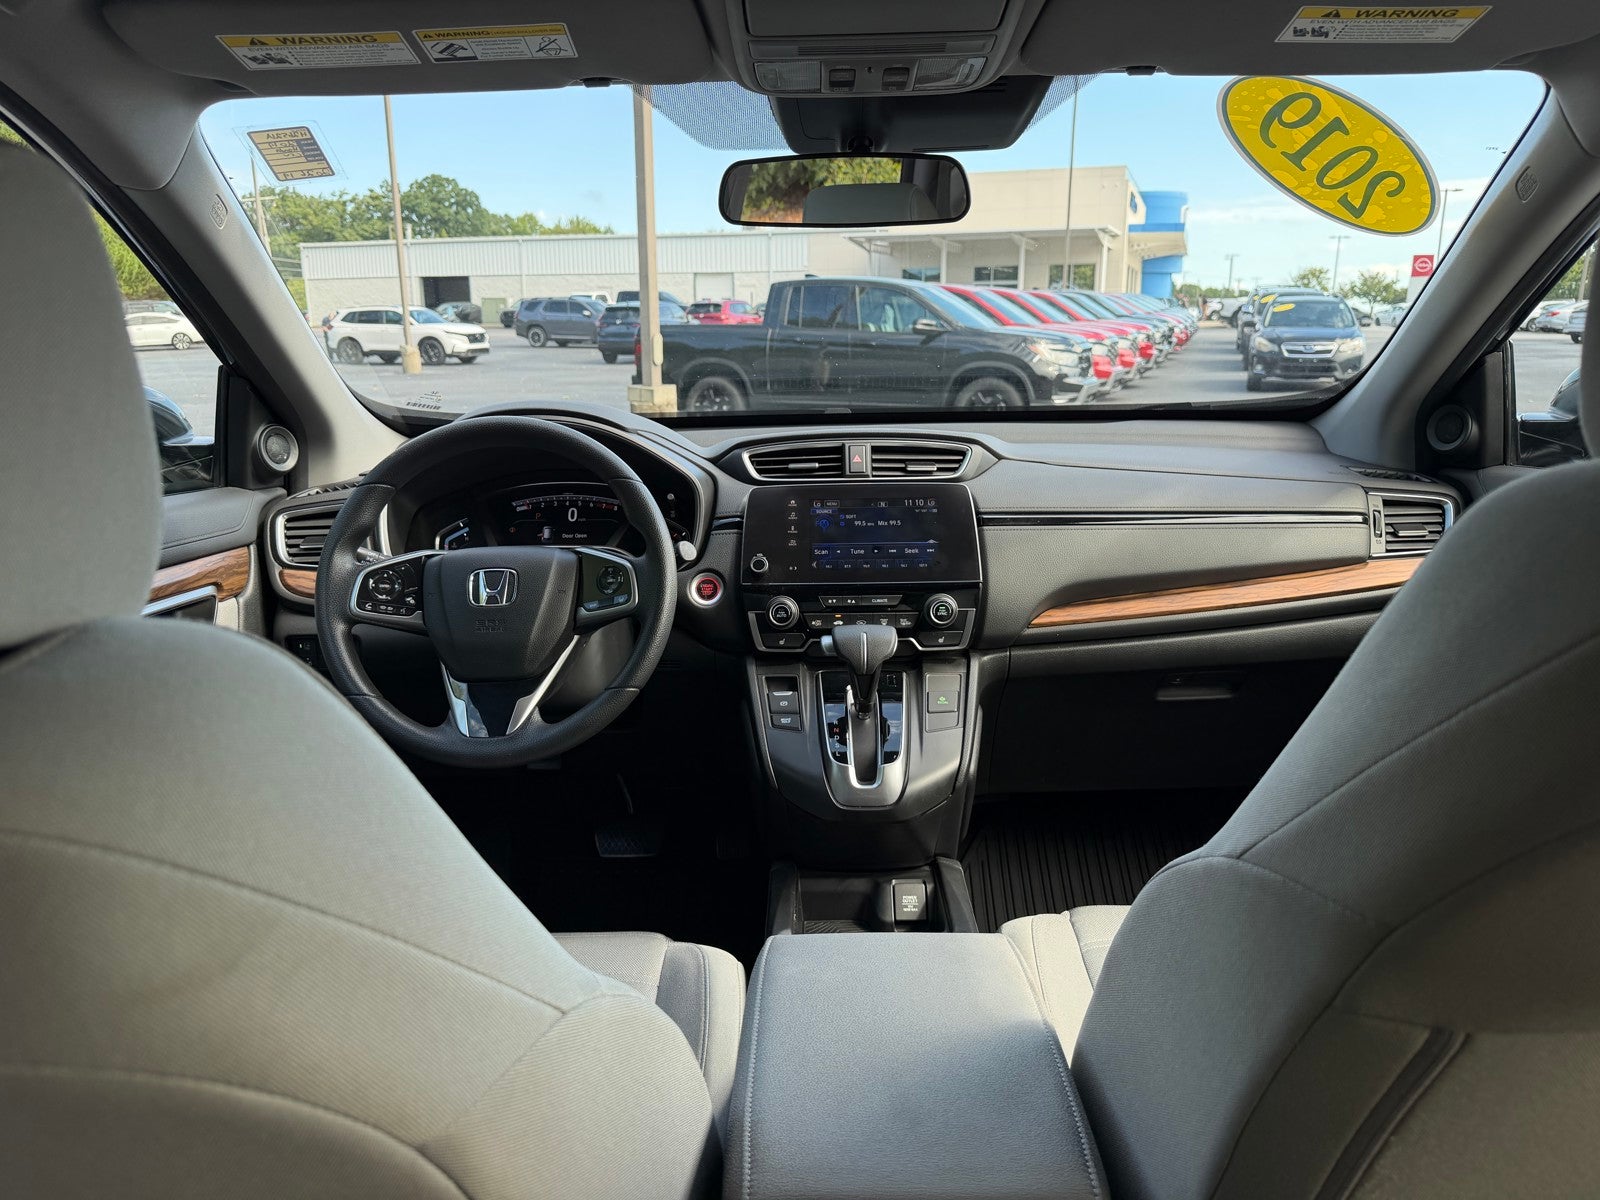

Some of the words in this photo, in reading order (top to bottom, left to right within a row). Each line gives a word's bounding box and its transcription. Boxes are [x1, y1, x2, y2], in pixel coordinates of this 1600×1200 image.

[1355, 9, 1460, 18] WARNING
[276, 34, 378, 46] WARNING
[568, 508, 577, 522] 0
